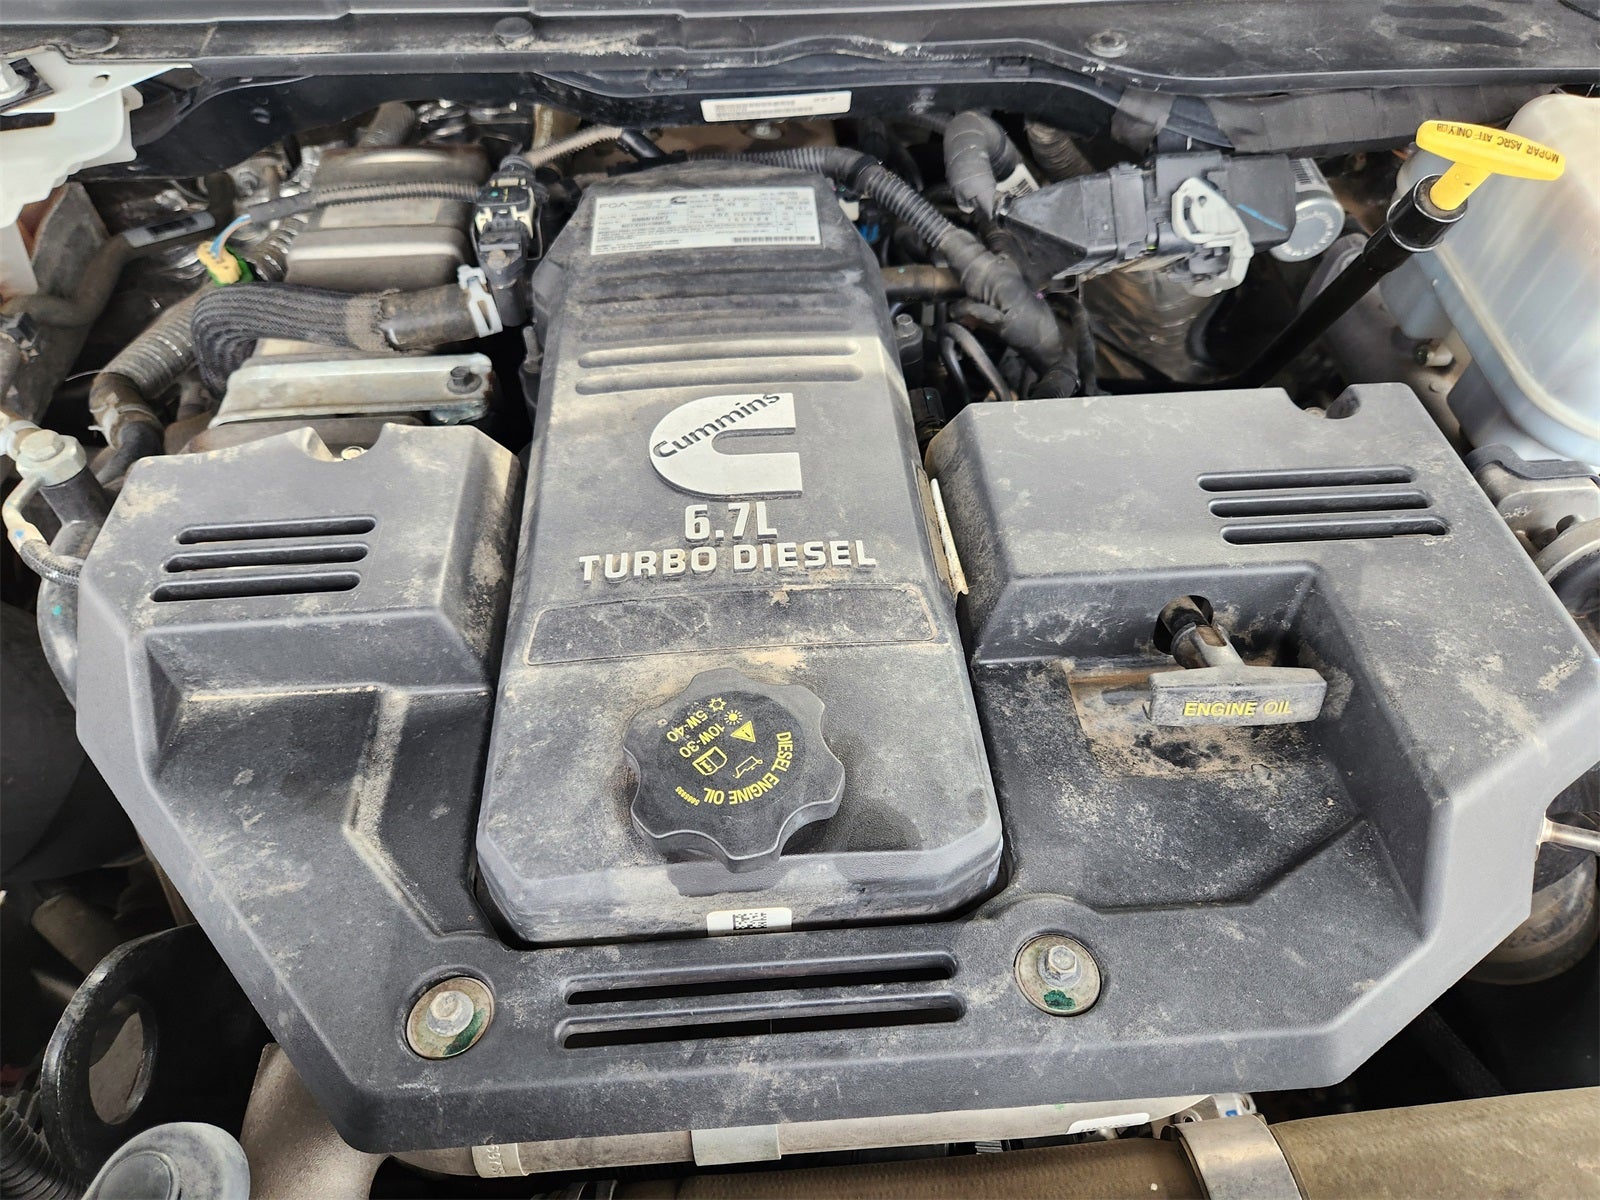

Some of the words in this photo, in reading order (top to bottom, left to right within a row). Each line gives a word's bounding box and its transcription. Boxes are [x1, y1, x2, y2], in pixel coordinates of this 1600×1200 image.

[1497, 136, 1523, 152] ASRC
[1526, 144, 1560, 164] MOPAR
[653, 392, 781, 458] Cummins
[684, 501, 778, 542] 6.7L
[578, 546, 718, 584] TURBO
[732, 540, 877, 574] DIESEL
[1183, 700, 1258, 717] ENGINE
[1263, 699, 1294, 715] OIL
[666, 710, 709, 742] 5W-40
[679, 723, 725, 758] 10W-30
[771, 731, 794, 772] DIESEL
[703, 787, 725, 805] OIL
[728, 772, 780, 805] ENGINE
